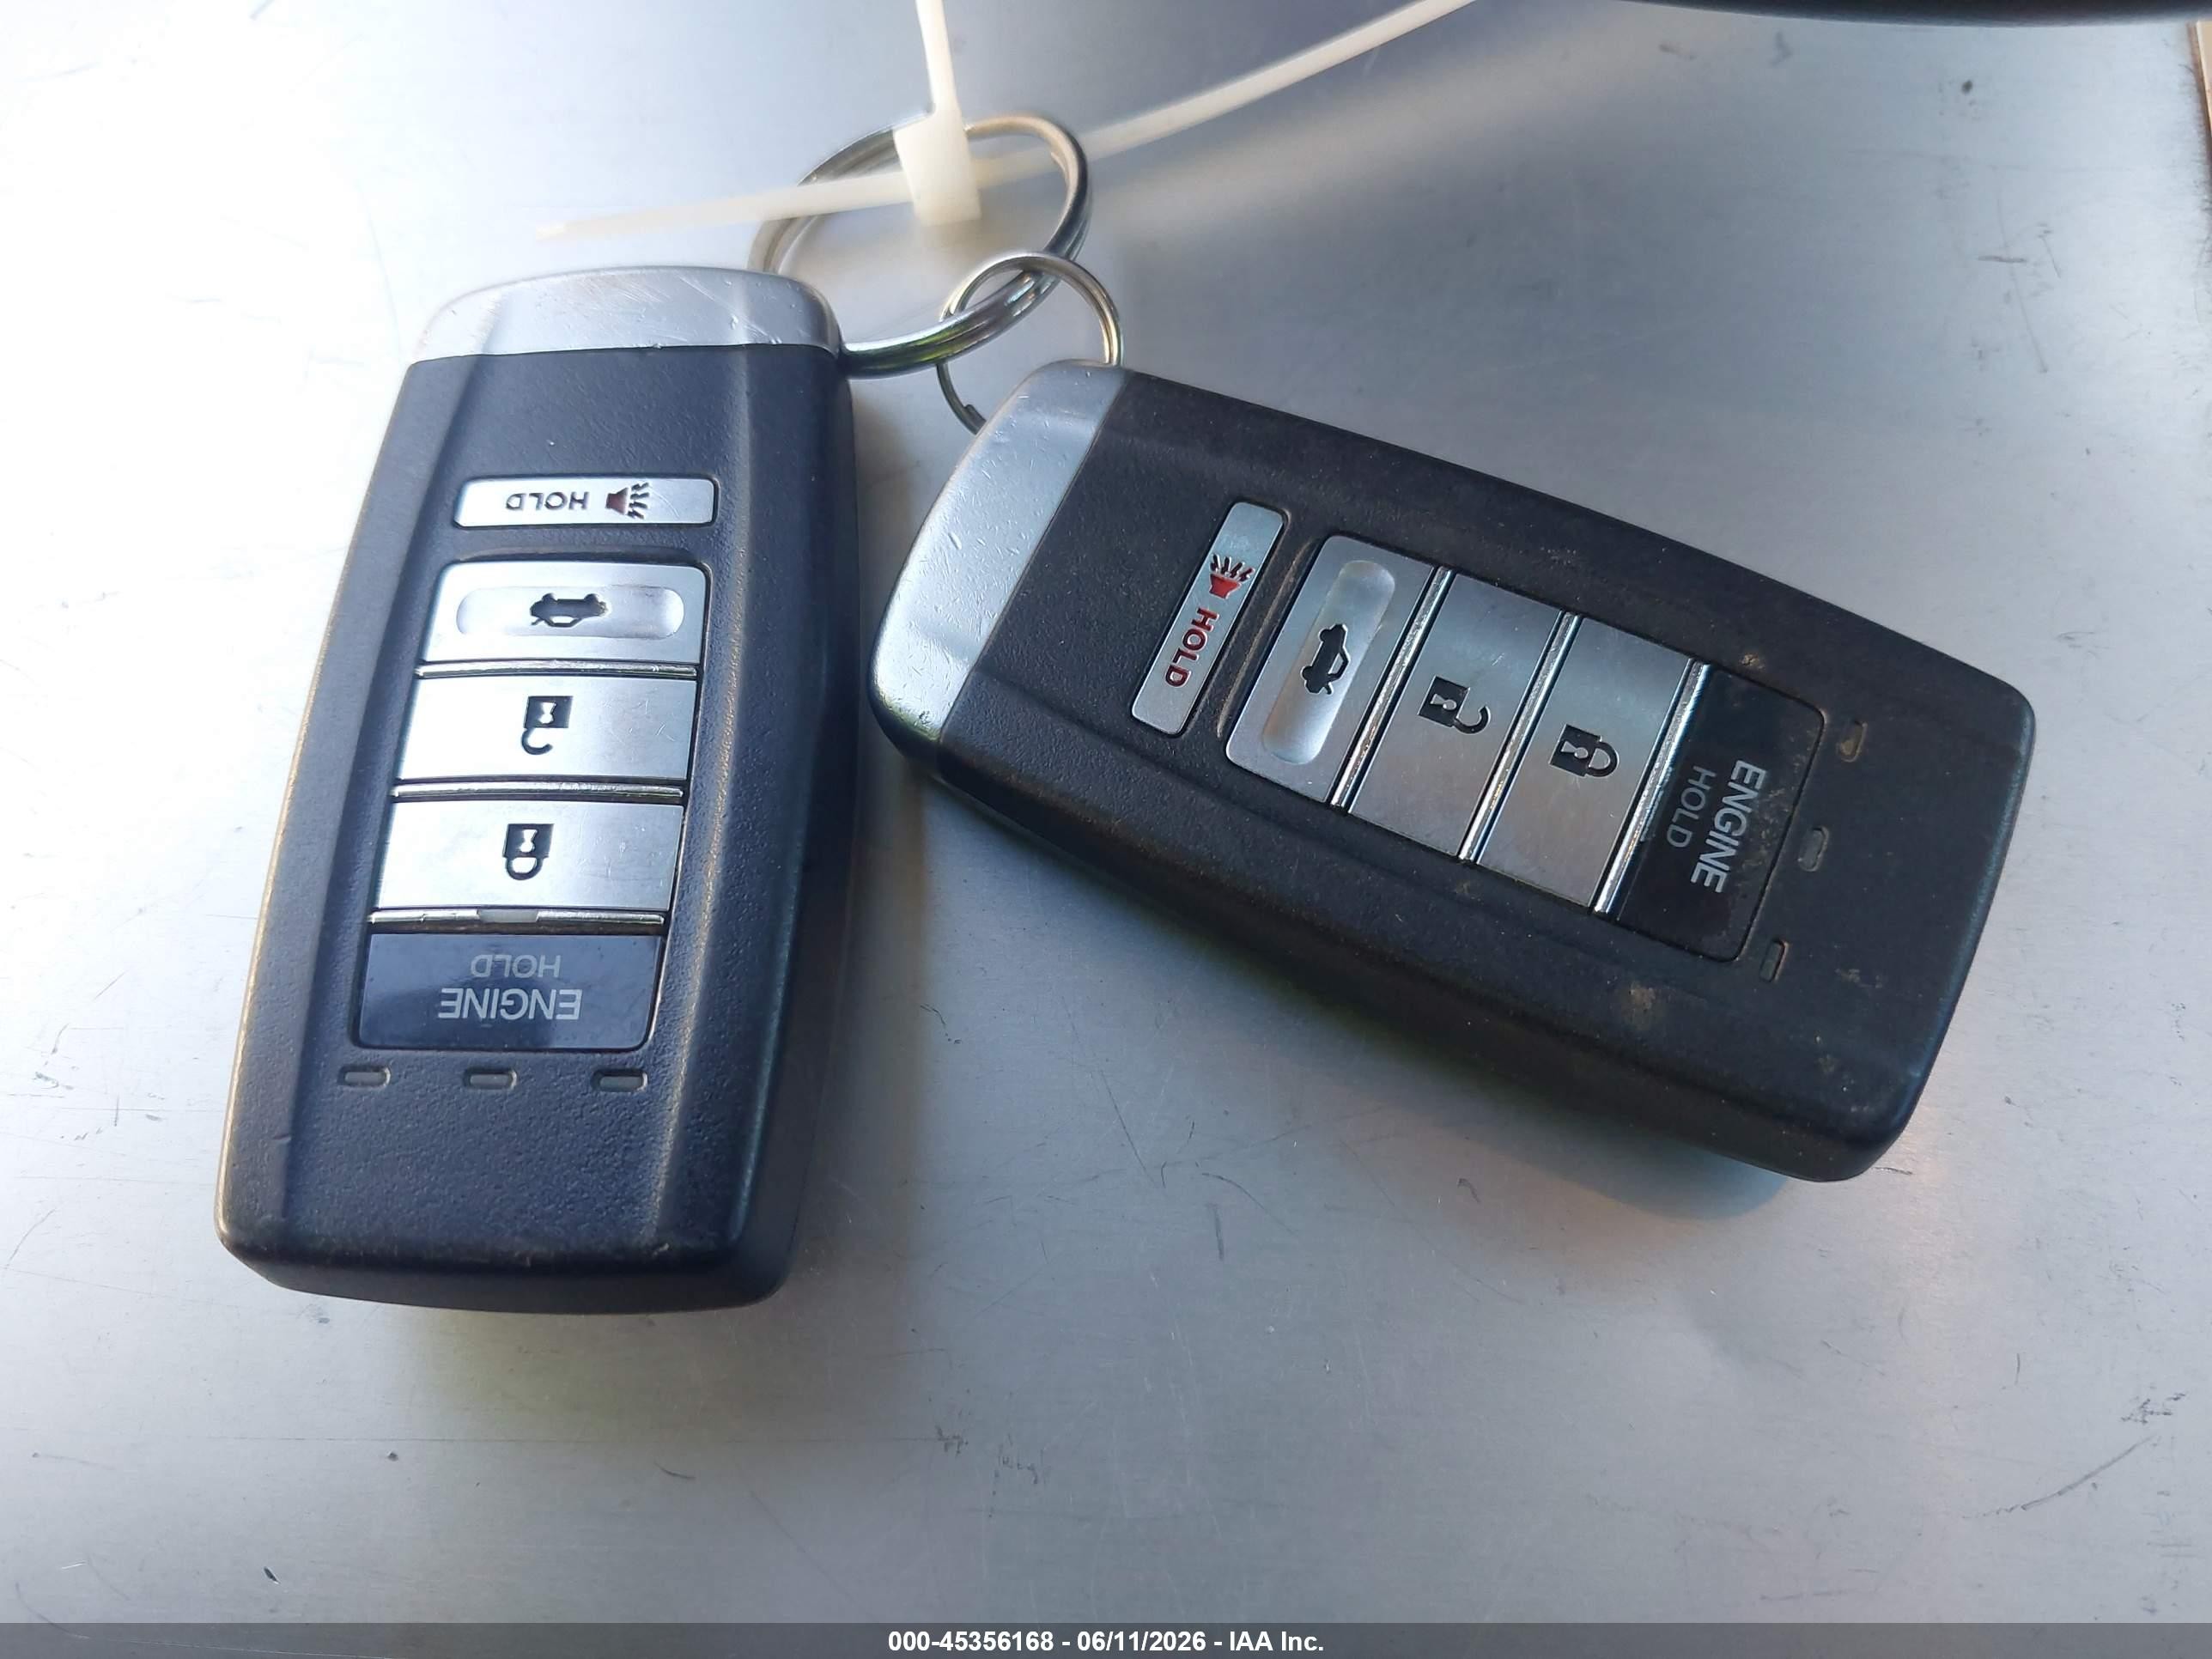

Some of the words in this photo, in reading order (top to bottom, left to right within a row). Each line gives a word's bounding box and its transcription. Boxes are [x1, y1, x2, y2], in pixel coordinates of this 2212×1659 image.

[505, 491, 591, 512] HOLD
[1164, 606, 1219, 688] HOLD
[1666, 765, 1717, 848] HOLD
[1690, 759, 1767, 894] ENGINE
[470, 954, 562, 978] HOLD
[437, 988, 583, 1021] ENGINE
